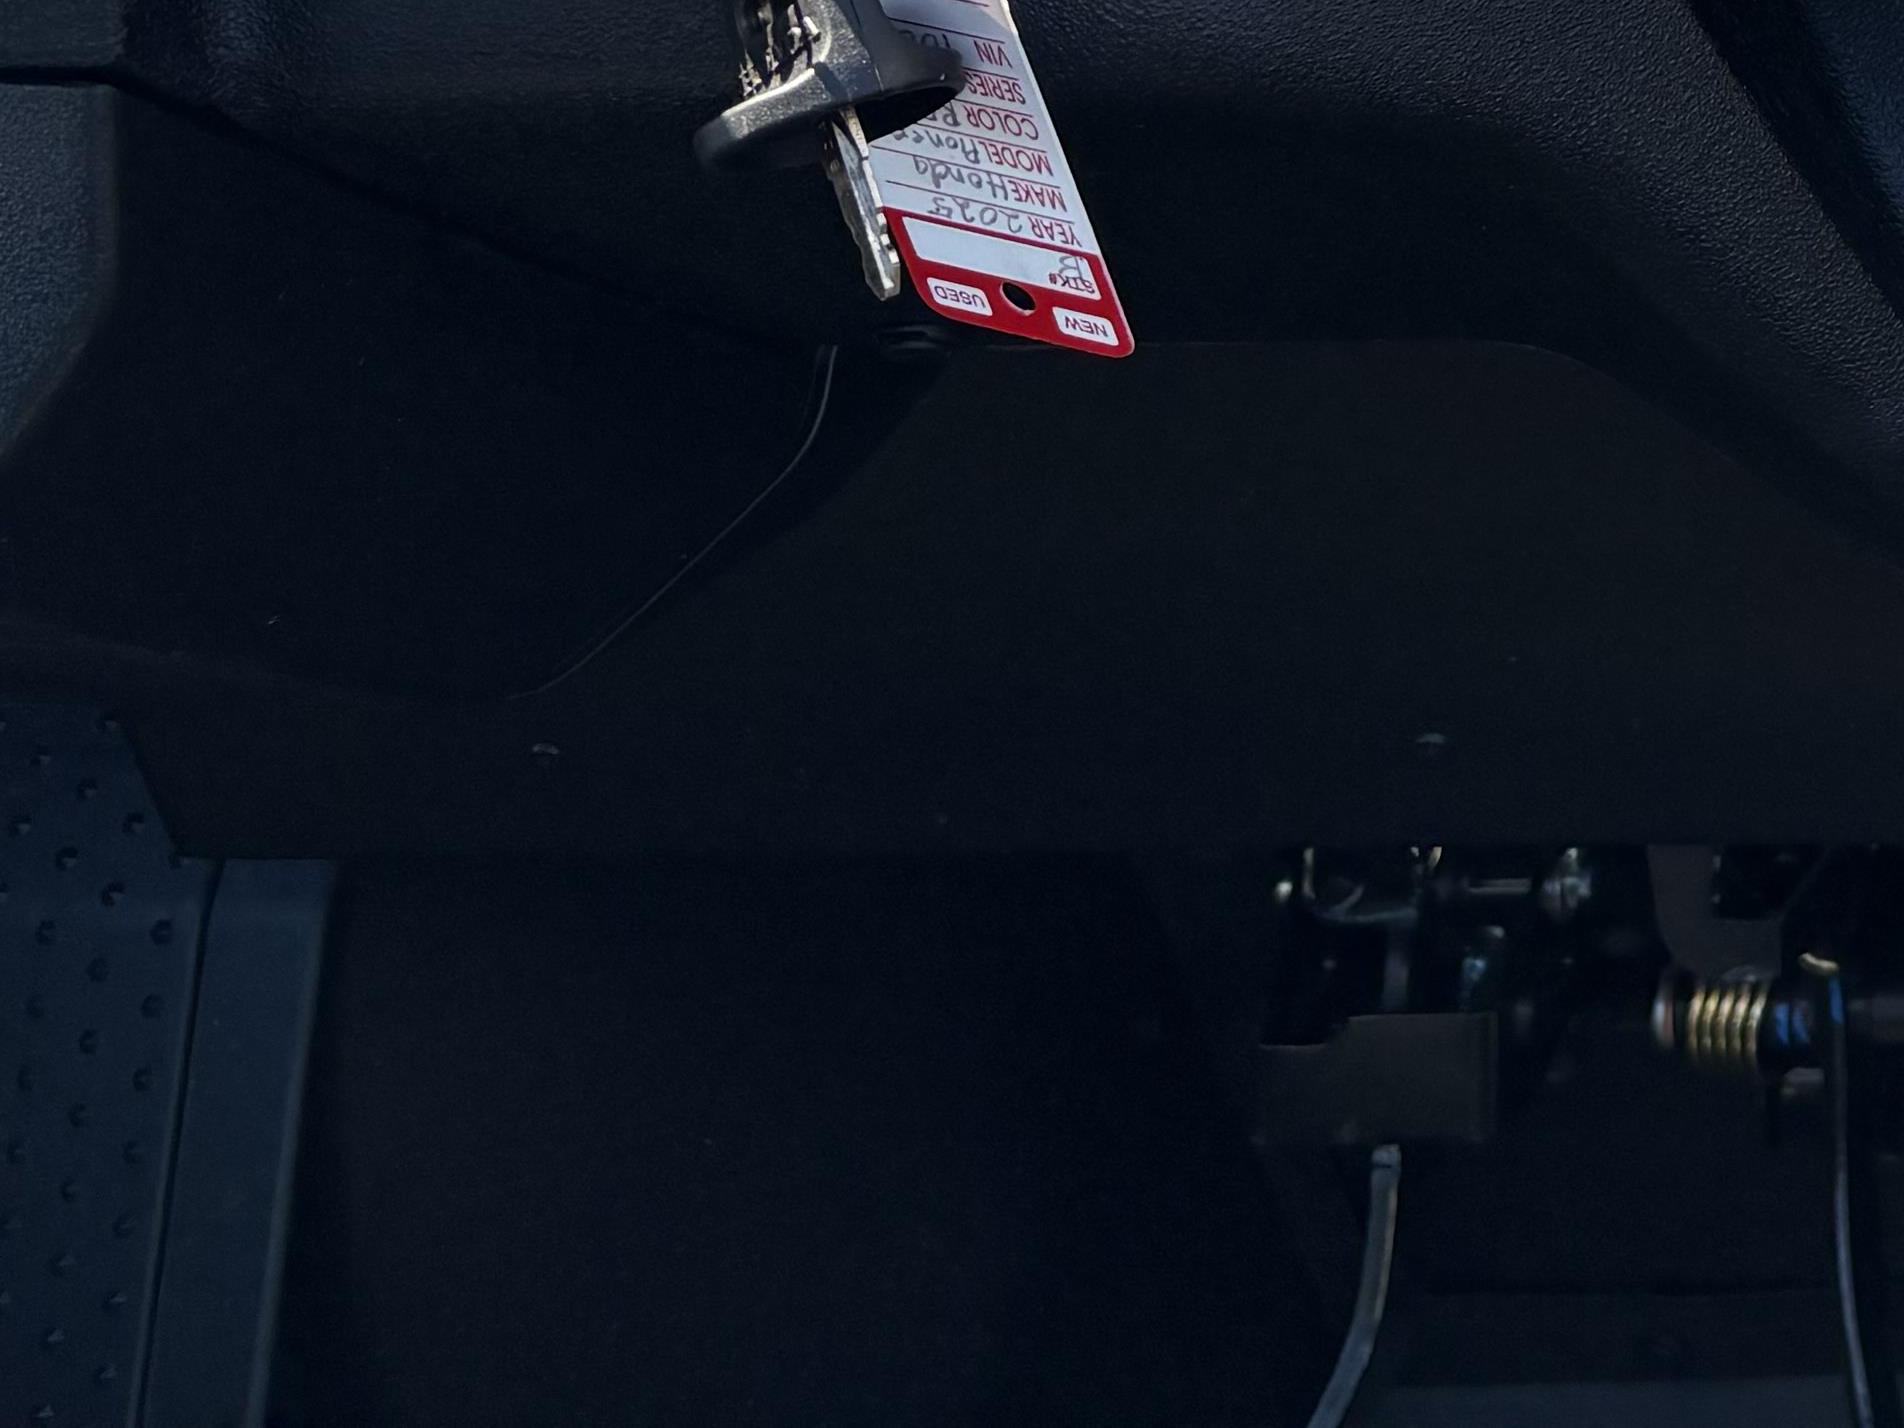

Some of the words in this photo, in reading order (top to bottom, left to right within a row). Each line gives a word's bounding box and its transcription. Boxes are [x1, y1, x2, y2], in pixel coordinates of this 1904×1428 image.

[974, 40, 1013, 68] VIN
[964, 104, 1039, 140] COLOR
[982, 142, 1054, 176] MODEL
[913, 154, 1009, 198] Honda
[1008, 178, 1067, 213] MAKE
[928, 196, 1023, 234] 2025
[1030, 216, 1082, 247] YEAR
[934, 284, 987, 309] USED
[1048, 272, 1096, 295] STK#
[1064, 315, 1109, 338] NEW
